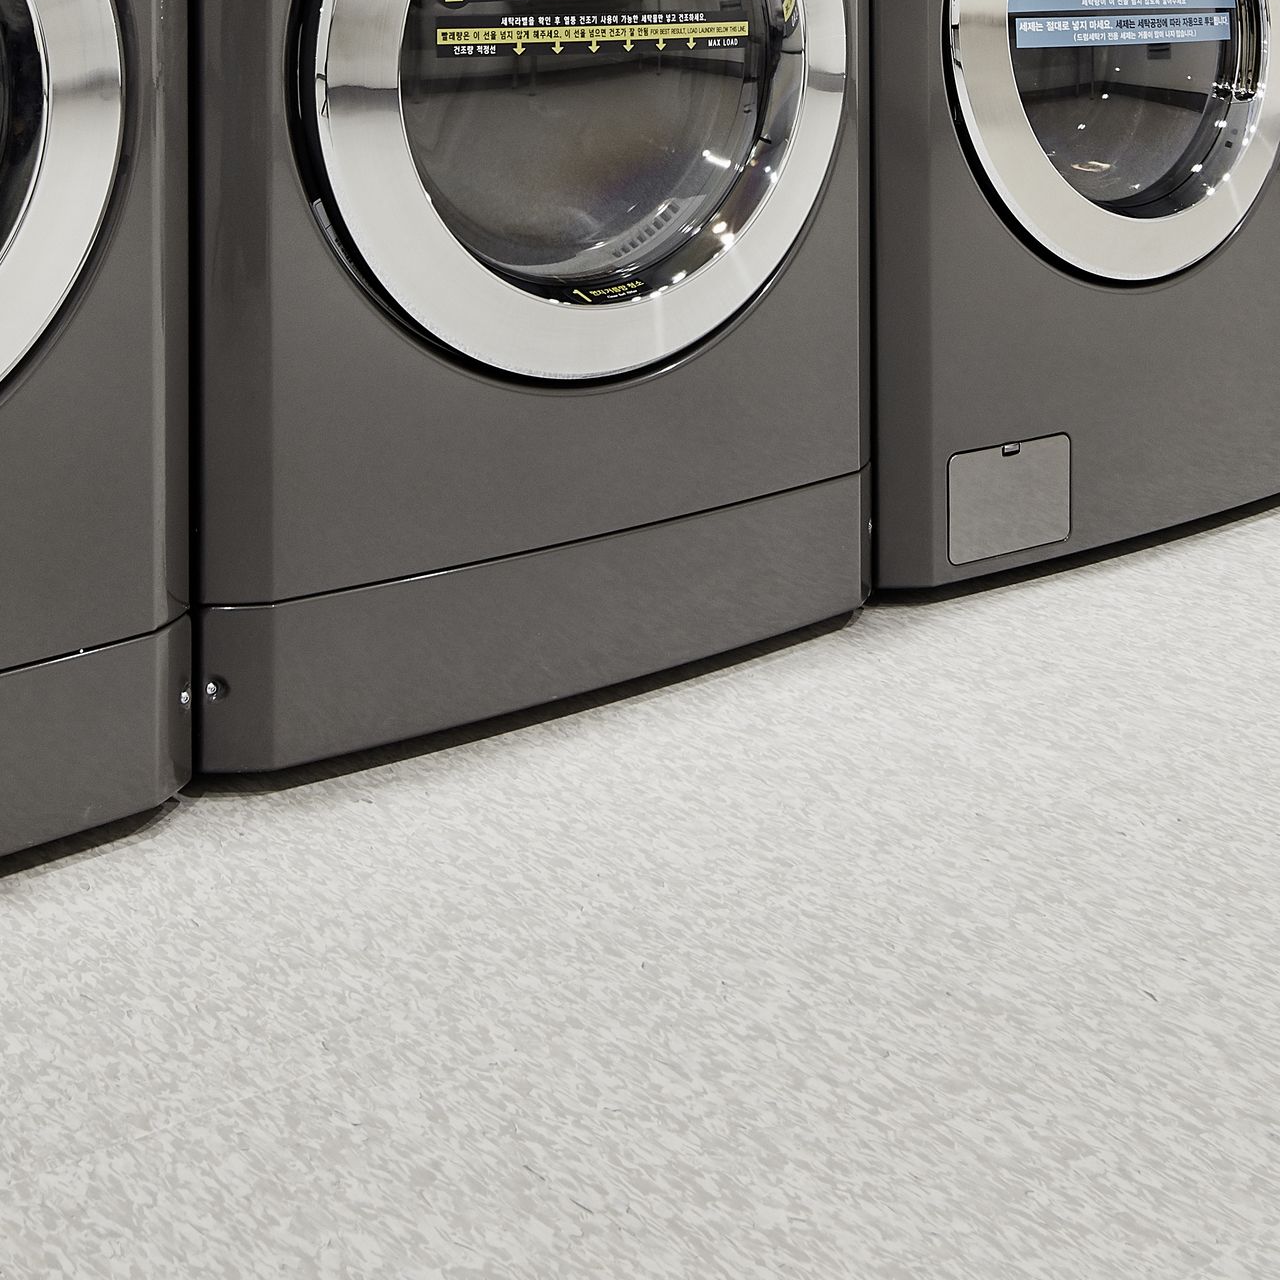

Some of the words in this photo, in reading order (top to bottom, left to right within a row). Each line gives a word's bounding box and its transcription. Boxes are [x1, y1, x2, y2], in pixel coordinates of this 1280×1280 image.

[579, 15, 598, 25] 건조기
[1019, 21, 1043, 32] 세제는
[473, 30, 480, 41] 이
[483, 30, 497, 41] 선을
[500, 30, 513, 40] 넘지
[516, 29, 530, 40] 않게
[532, 28, 562, 39] 해주세요.
[453, 45, 474, 55] 건조량
[476, 44, 496, 55] 적정선
[708, 39, 721, 47] MAX
[722, 38, 738, 47] LOAD
